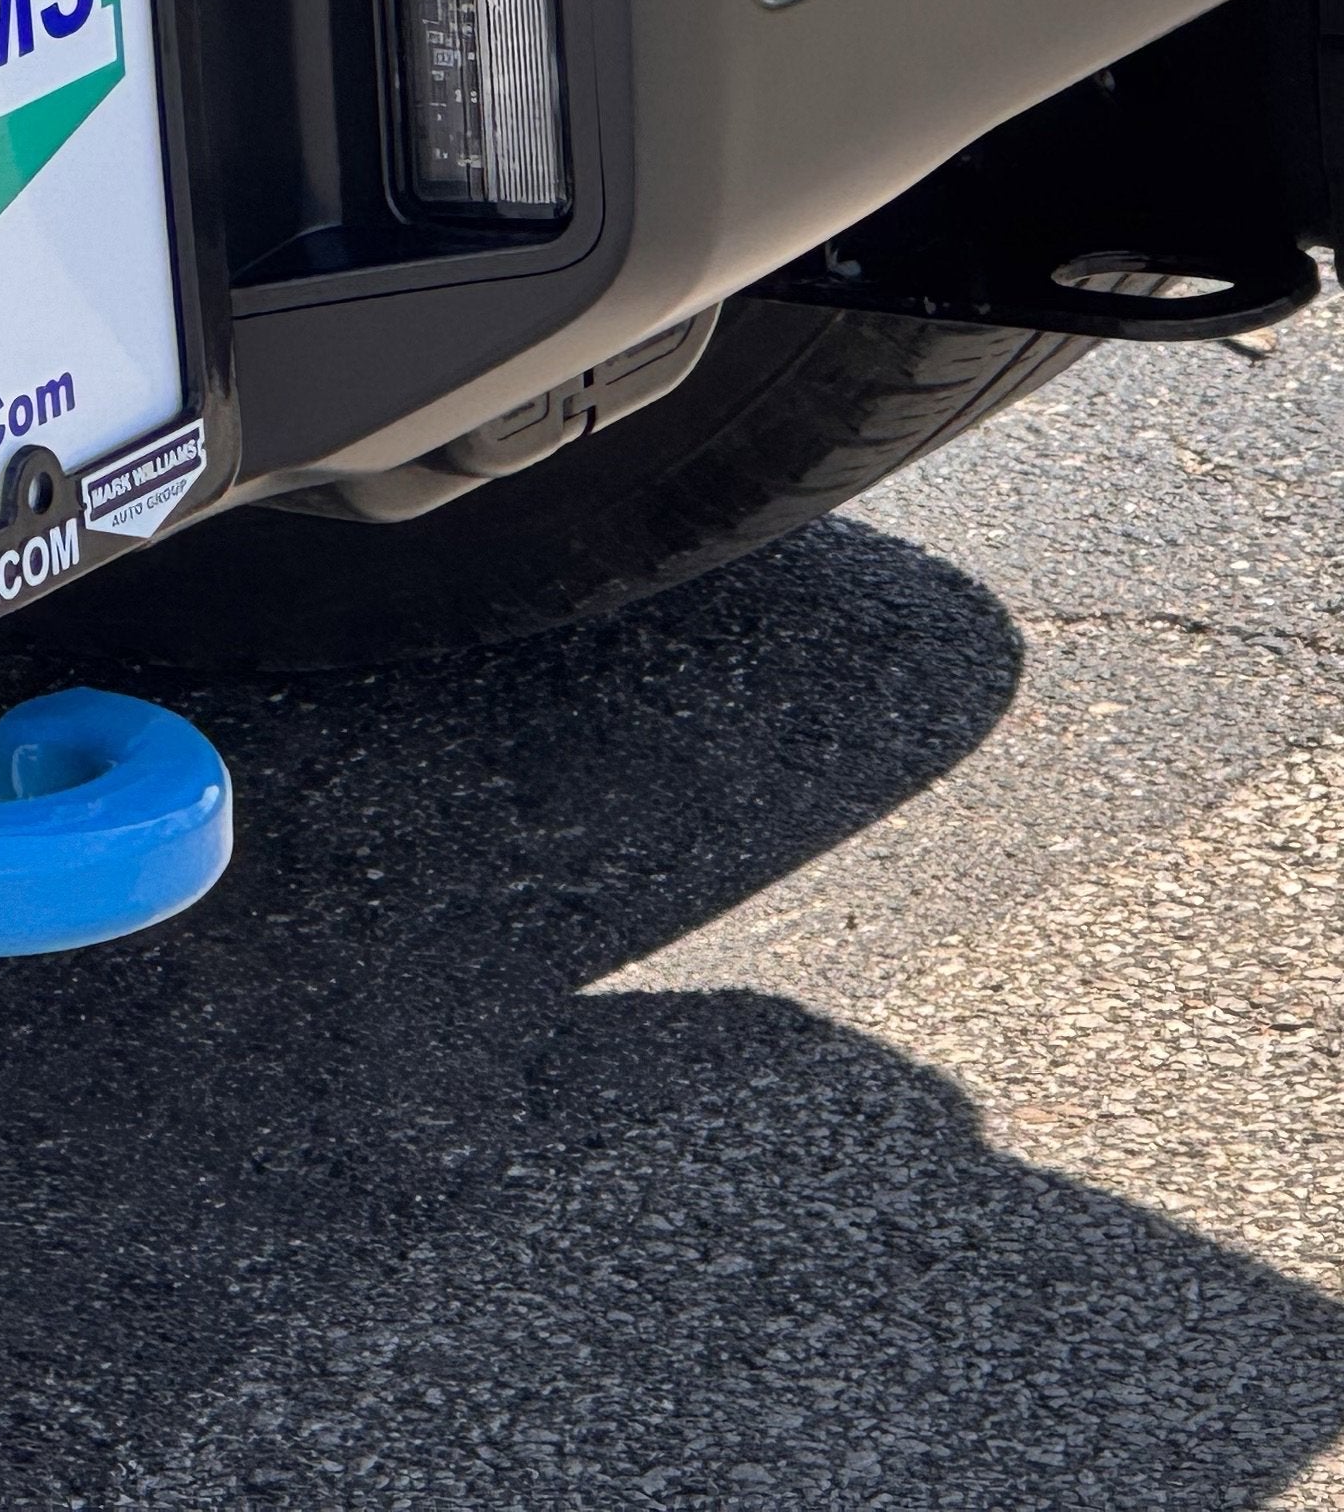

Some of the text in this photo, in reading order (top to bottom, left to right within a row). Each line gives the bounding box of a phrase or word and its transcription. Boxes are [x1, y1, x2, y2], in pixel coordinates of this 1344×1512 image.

[90, 439, 197, 509] MARK WILLIAMS
[111, 478, 188, 528] AUTO GROUP
